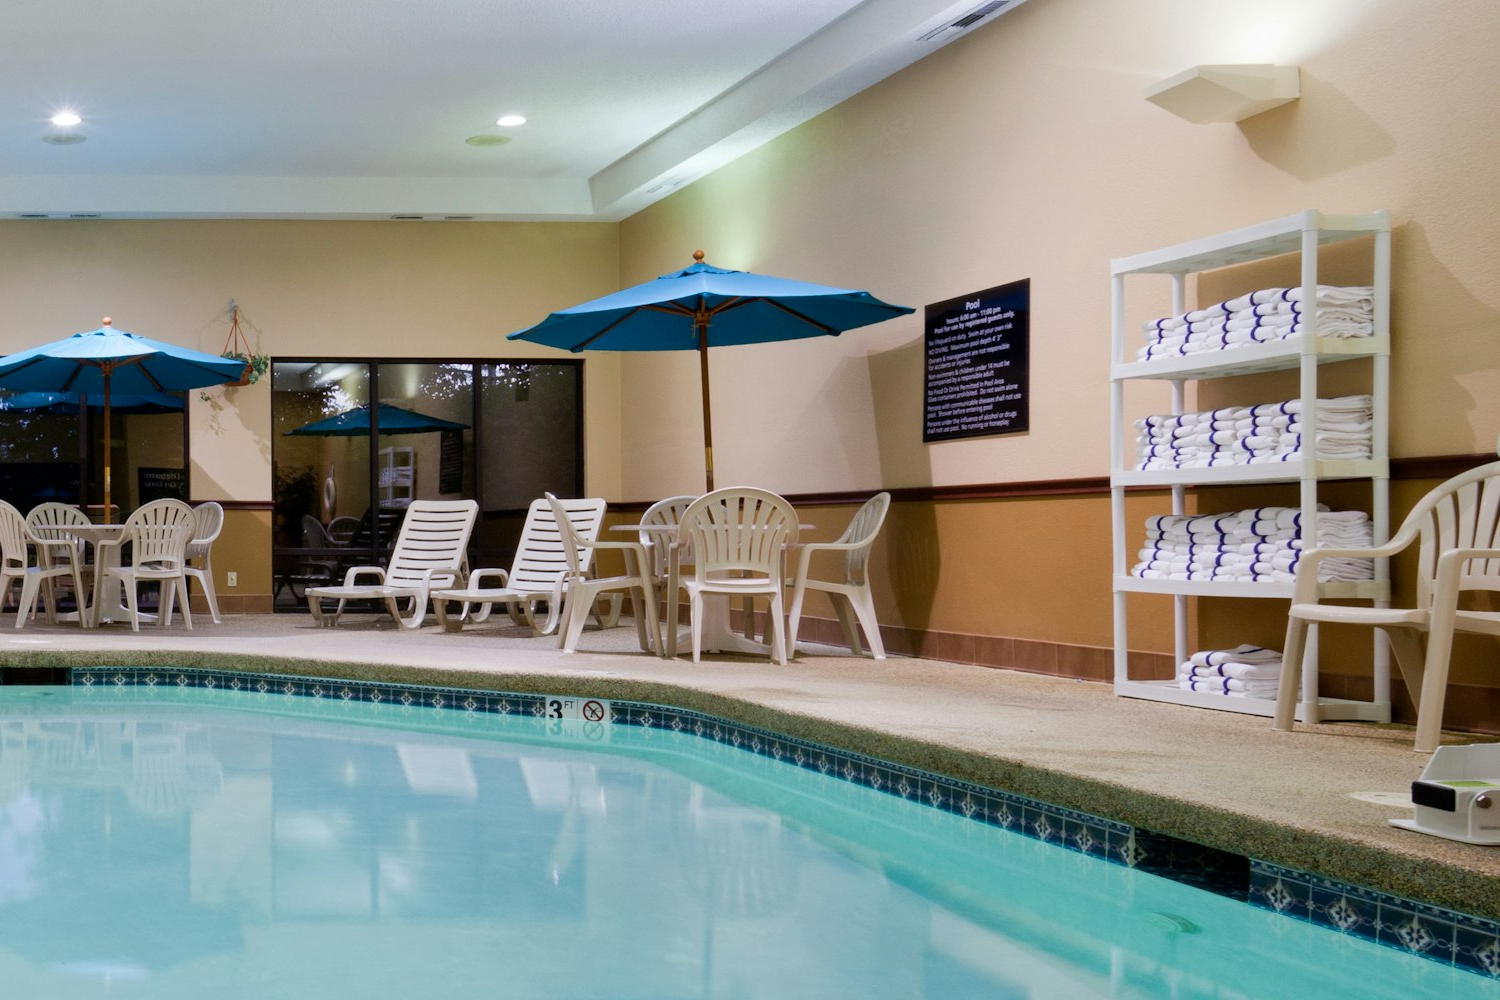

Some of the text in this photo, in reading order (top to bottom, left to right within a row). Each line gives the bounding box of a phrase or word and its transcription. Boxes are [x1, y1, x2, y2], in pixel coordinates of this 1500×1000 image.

[966, 298, 980, 311] Pool
[981, 308, 992, 316] 11:00
[934, 327, 943, 335] Pool
[965, 317, 987, 329] registered
[988, 313, 1002, 324] guests
[968, 330, 979, 338] Swim
[970, 339, 979, 348] pool
[980, 336, 992, 345] depth
[946, 351, 971, 362] management
[987, 343, 1010, 354] responsible
[959, 366, 974, 374] children
[961, 372, 982, 382] responsible
[966, 406, 982, 414] entering
[968, 422, 983, 430] running
[549, 700, 575, 719] 3 FT
